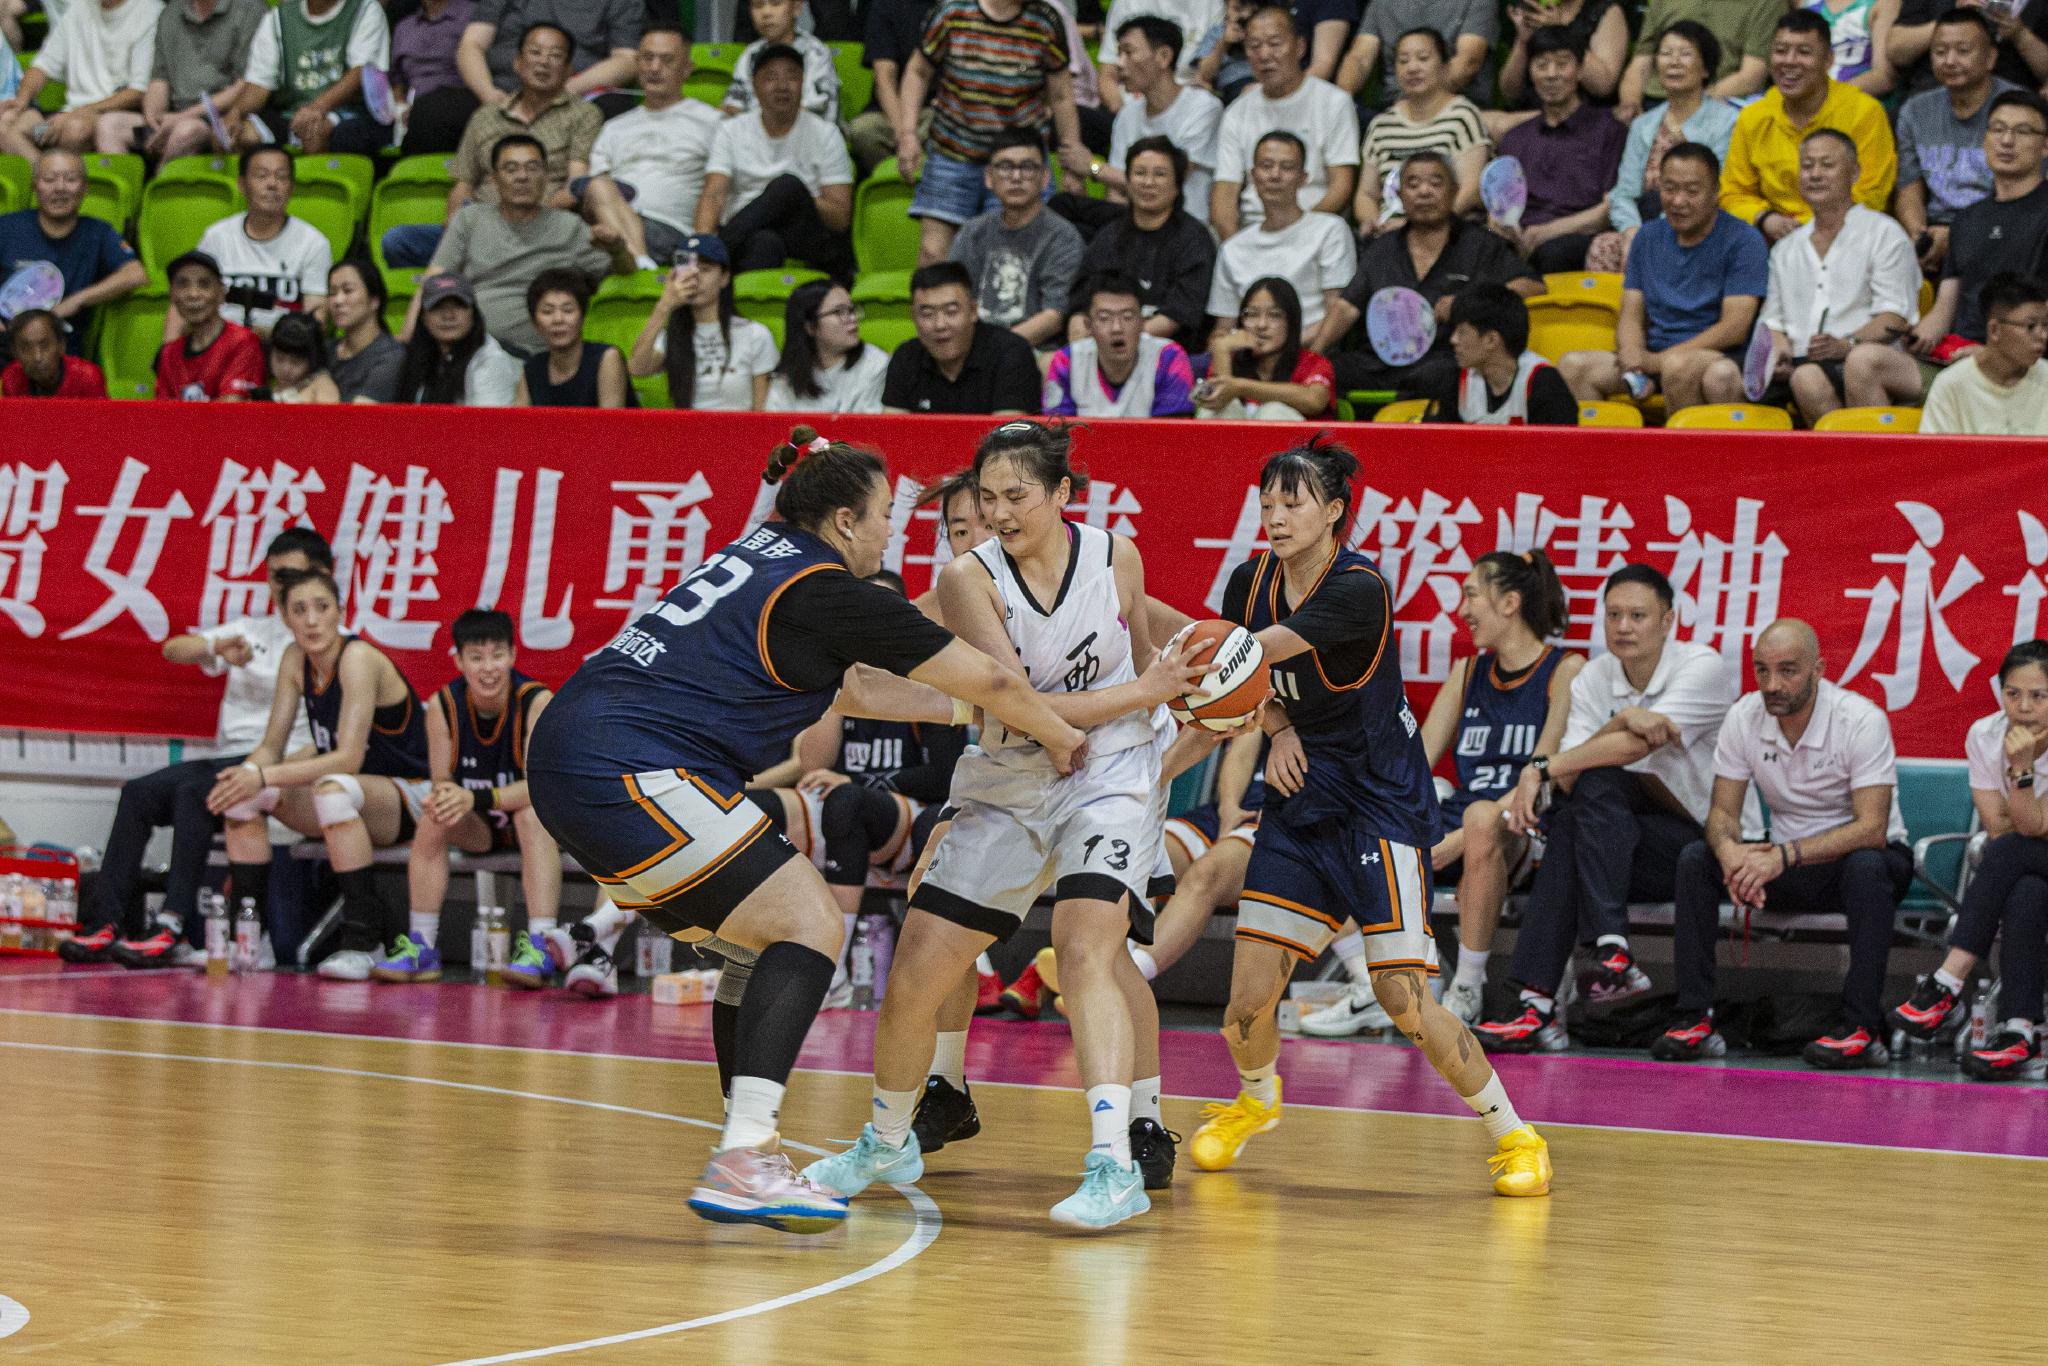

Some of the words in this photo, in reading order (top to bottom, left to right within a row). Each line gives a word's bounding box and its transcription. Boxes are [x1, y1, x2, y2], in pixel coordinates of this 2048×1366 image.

[1219, 631, 1255, 685] anhua
[1457, 724, 1536, 756] 四川
[1469, 764, 1512, 792] 21
[1083, 834, 1130, 871] 13
